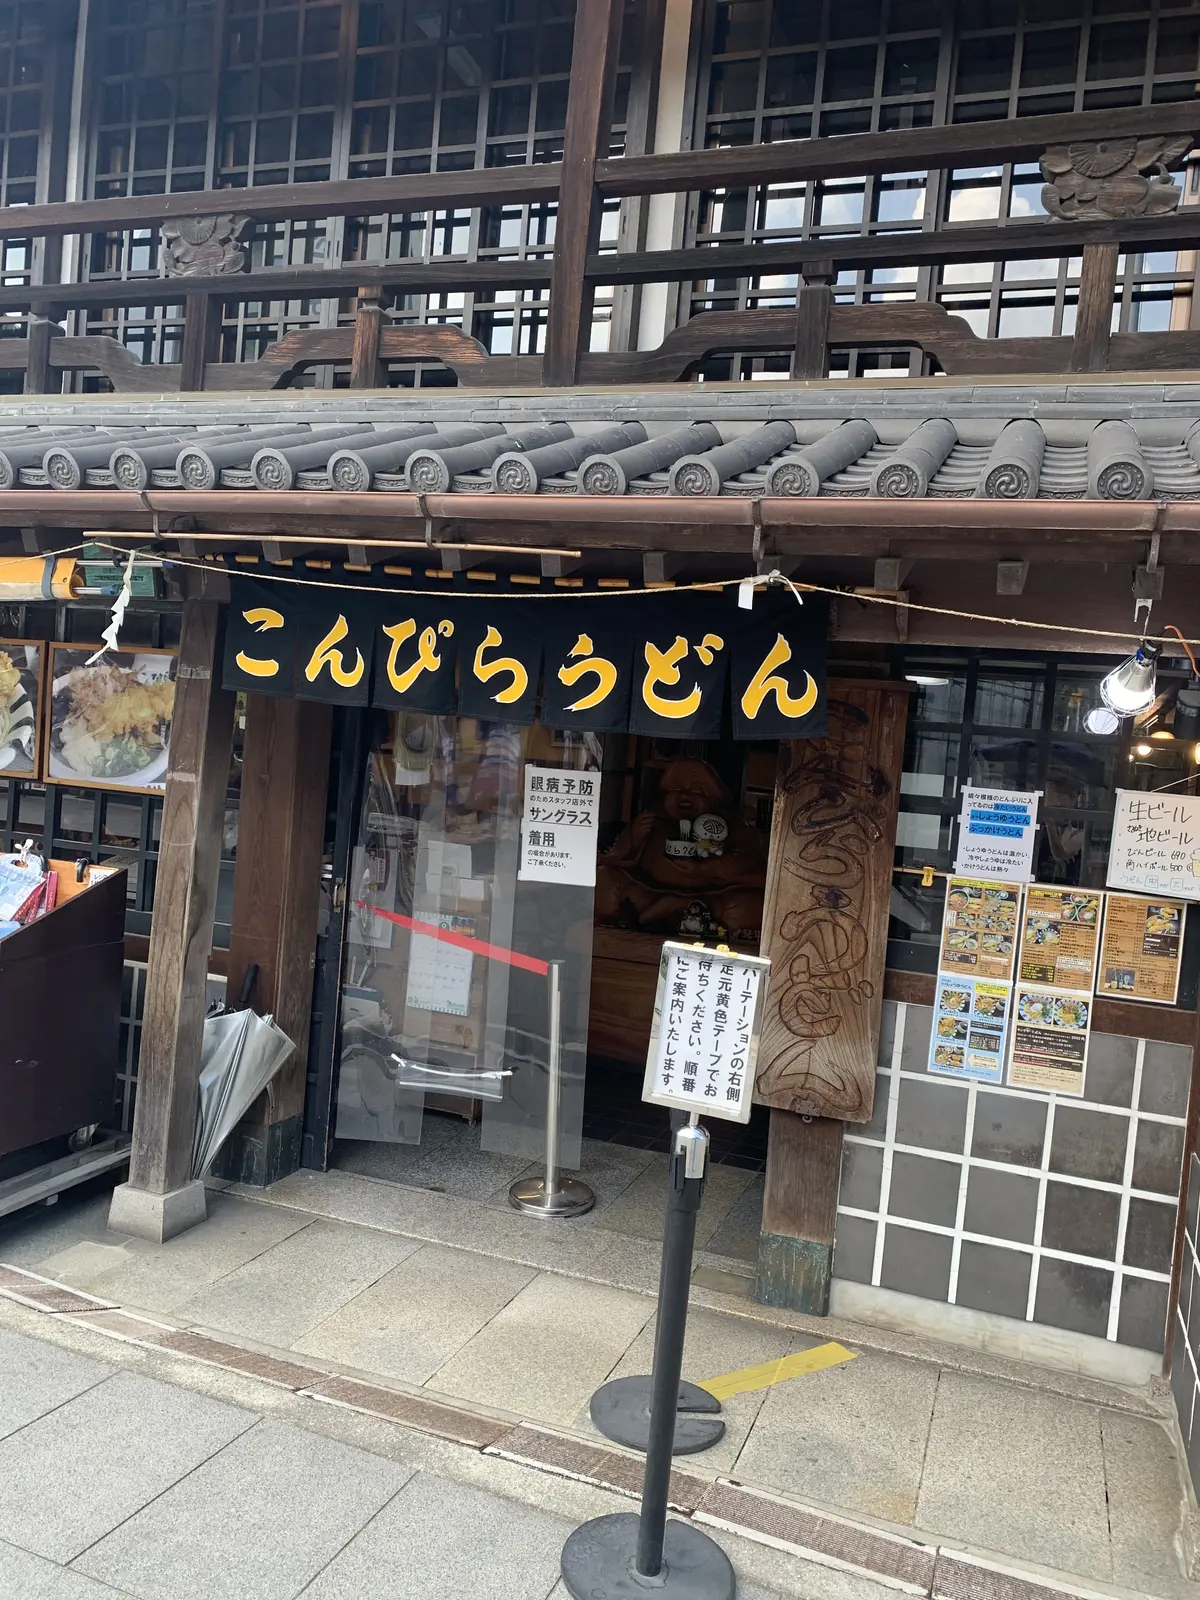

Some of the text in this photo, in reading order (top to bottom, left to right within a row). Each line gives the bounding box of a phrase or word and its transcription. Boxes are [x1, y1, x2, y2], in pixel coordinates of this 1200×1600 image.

[235, 606, 819, 721] こんぴらうどん
[531, 776, 594, 795] 眼病予防
[529, 796, 594, 807] のためスタッフ店外で
[529, 807, 592, 825] サングラス
[1129, 800, 1193, 824] 生ビール
[528, 830, 555, 847] 着用
[1135, 827, 1194, 846] 地ビール
[527, 849, 573, 860] の場合があります。
[527, 858, 567, 868] ご了承ください。
[1127, 848, 1186, 861] びんビール 690
[1125, 859, 1183, 872] 角ハイボール 500
